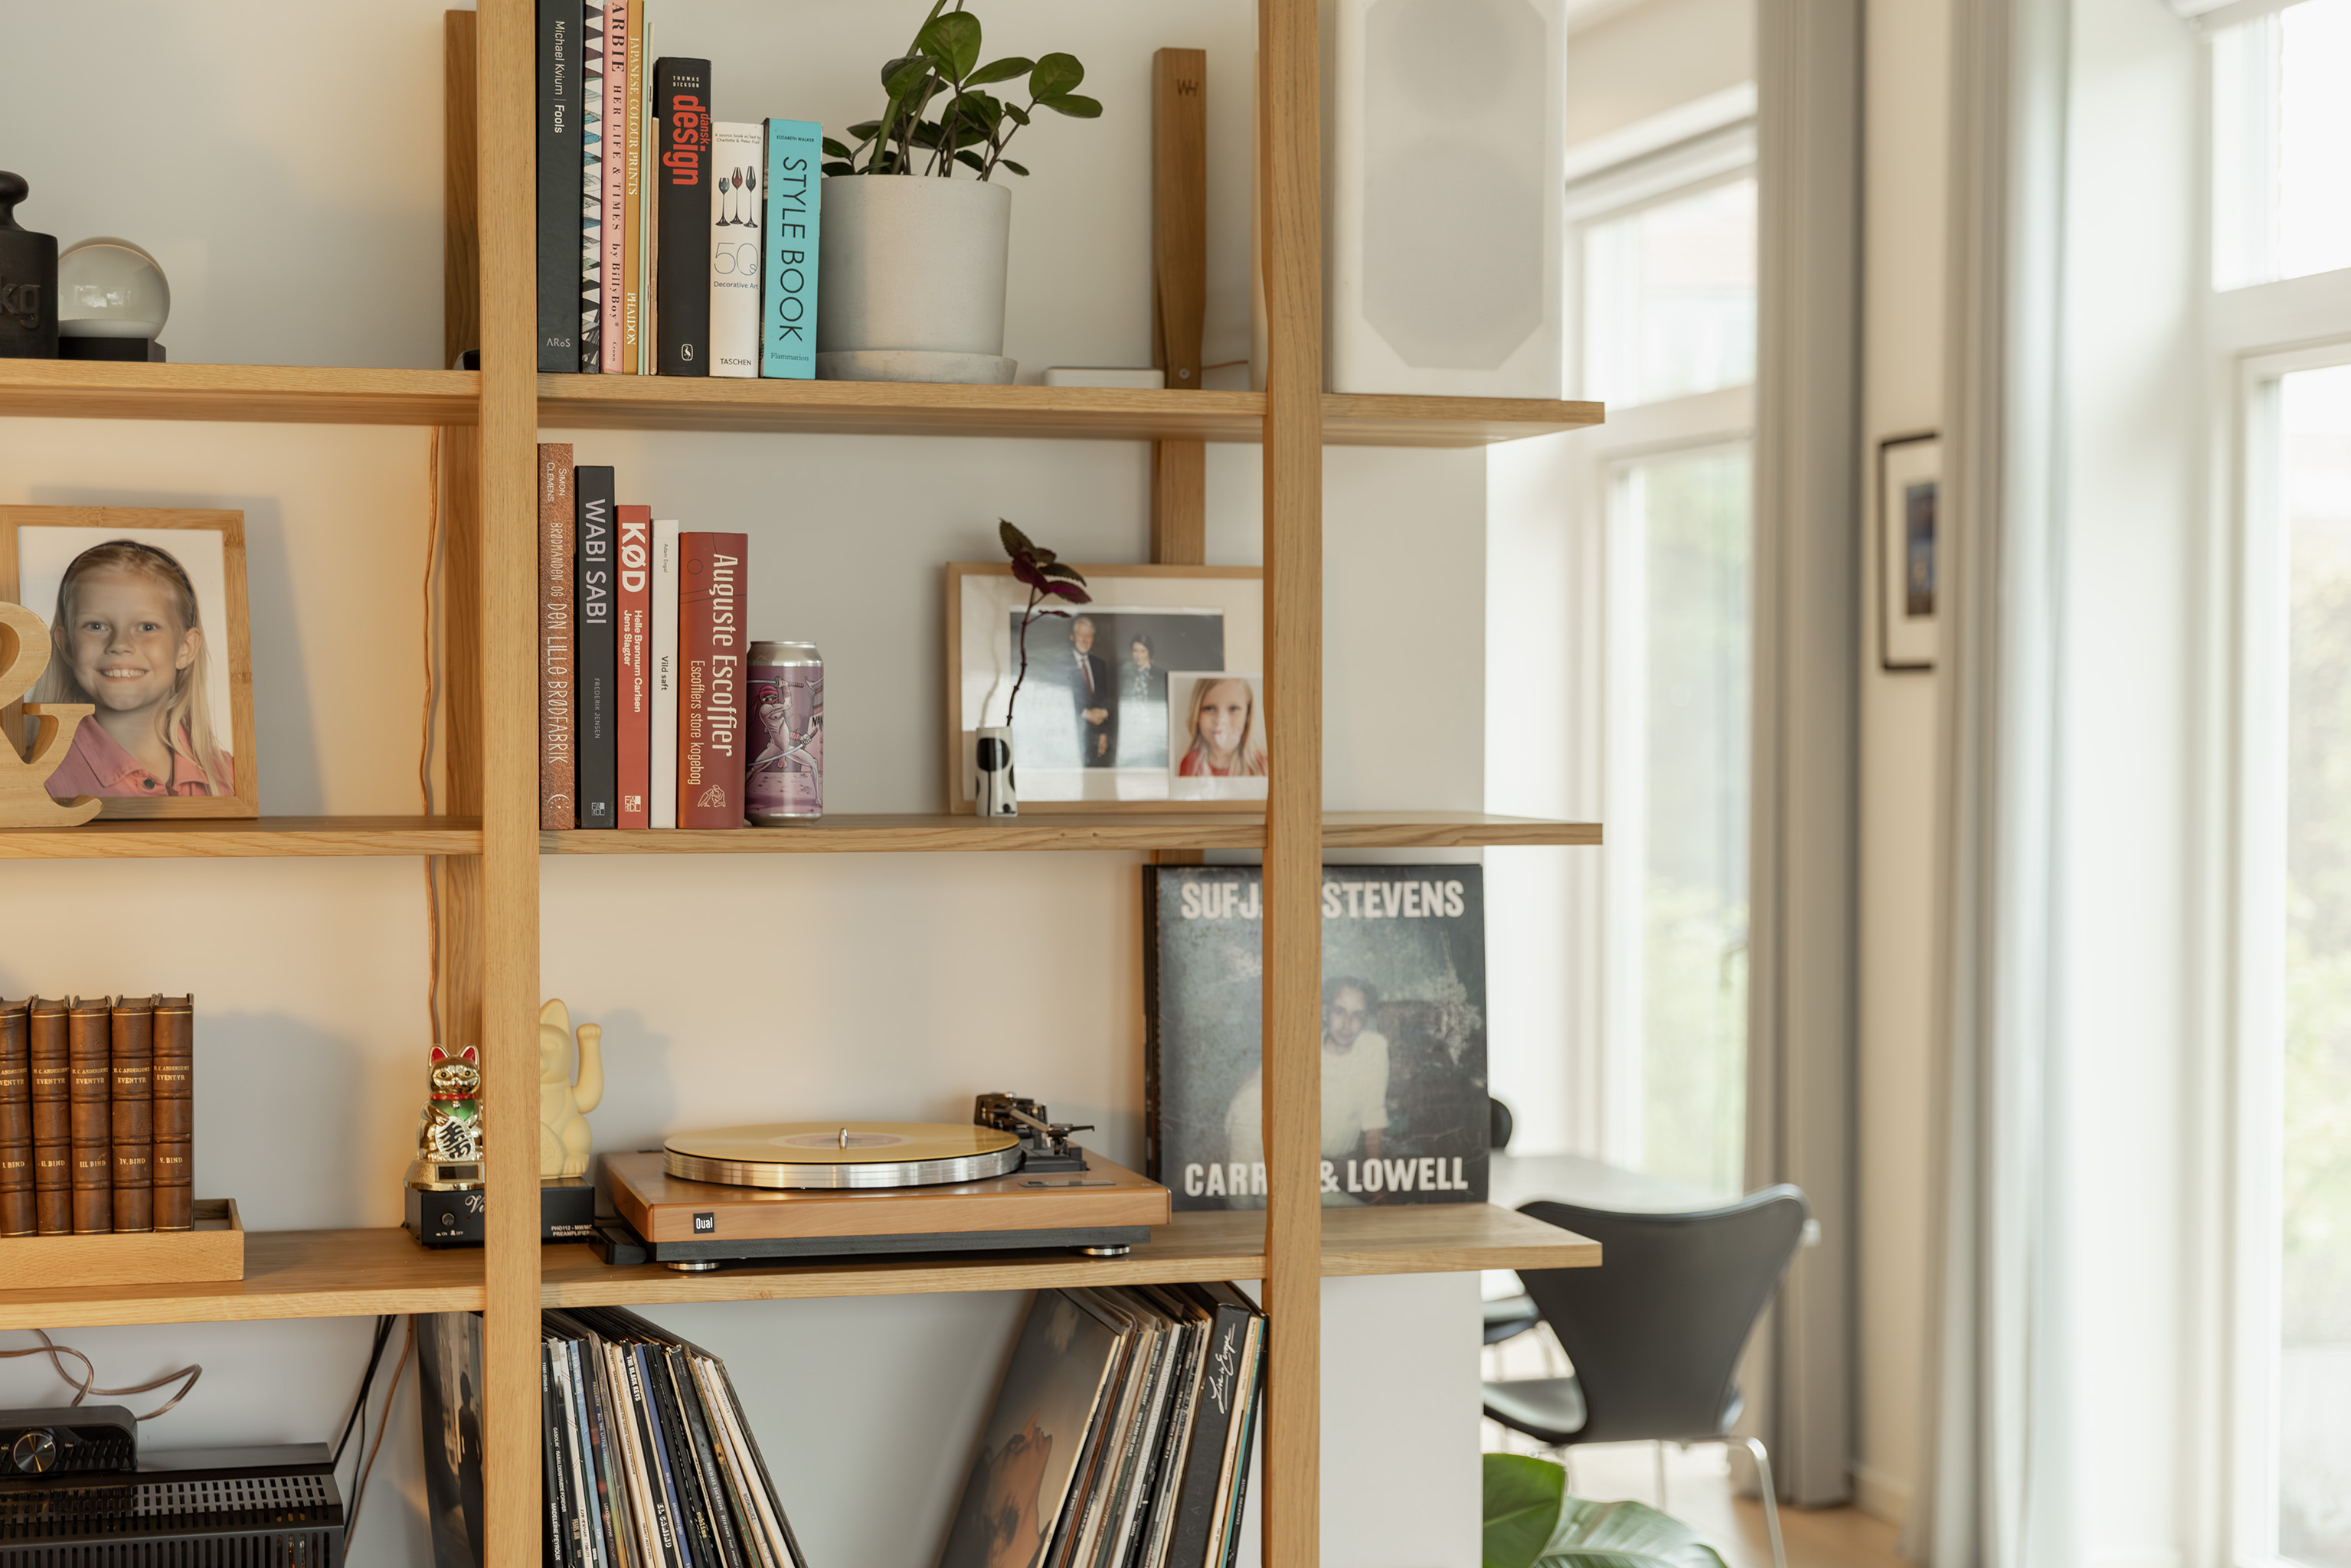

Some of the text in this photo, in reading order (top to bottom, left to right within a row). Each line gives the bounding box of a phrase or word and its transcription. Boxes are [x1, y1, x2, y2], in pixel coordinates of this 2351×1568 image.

[554, 21, 565, 133] Michael Kvium Fools
[613, 85, 622, 115] HER
[628, 36, 639, 195] JAPANESE COLOUR PRINTS
[613, 124, 621, 158] LIFE
[662, 95, 706, 185] design
[612, 183, 621, 230] TIMES
[610, 243, 620, 257] by
[779, 156, 807, 342] STYLE BOOK
[626, 292, 636, 345] PHAIDON
[770, 352, 809, 361] Flammarion
[547, 462, 555, 501] CLEMENS
[558, 468, 567, 496] SIMON
[585, 498, 607, 623] WABI SABI
[621, 522, 646, 593] KØD
[622, 633, 632, 666] Slagter
[634, 610, 643, 713] Helle Brønnum Carlsen
[707, 554, 738, 757] Auguste Escoffier
[548, 681, 568, 764] BRØDFABRIK
[687, 660, 705, 785] Escoffiers store kogebog
[1180, 880, 1464, 919] SUFJ STEVENS
[1185, 1161, 1268, 1197] CARR
[1347, 1157, 1469, 1194] LOWELL
[696, 1217, 713, 1229] Dual
[628, 1367, 638, 1386] BLACK
[633, 1385, 642, 1402] KEYS
[718, 1389, 731, 1414] DESTROYER
[613, 1383, 622, 1402] VAUGHAN
[623, 1435, 633, 1455] GERSHWIN
[706, 1462, 724, 1511] MICHAEL JACKSON
[743, 1492, 757, 1521] RODRIGUEZ
[657, 1502, 673, 1548] EL CAMINO
